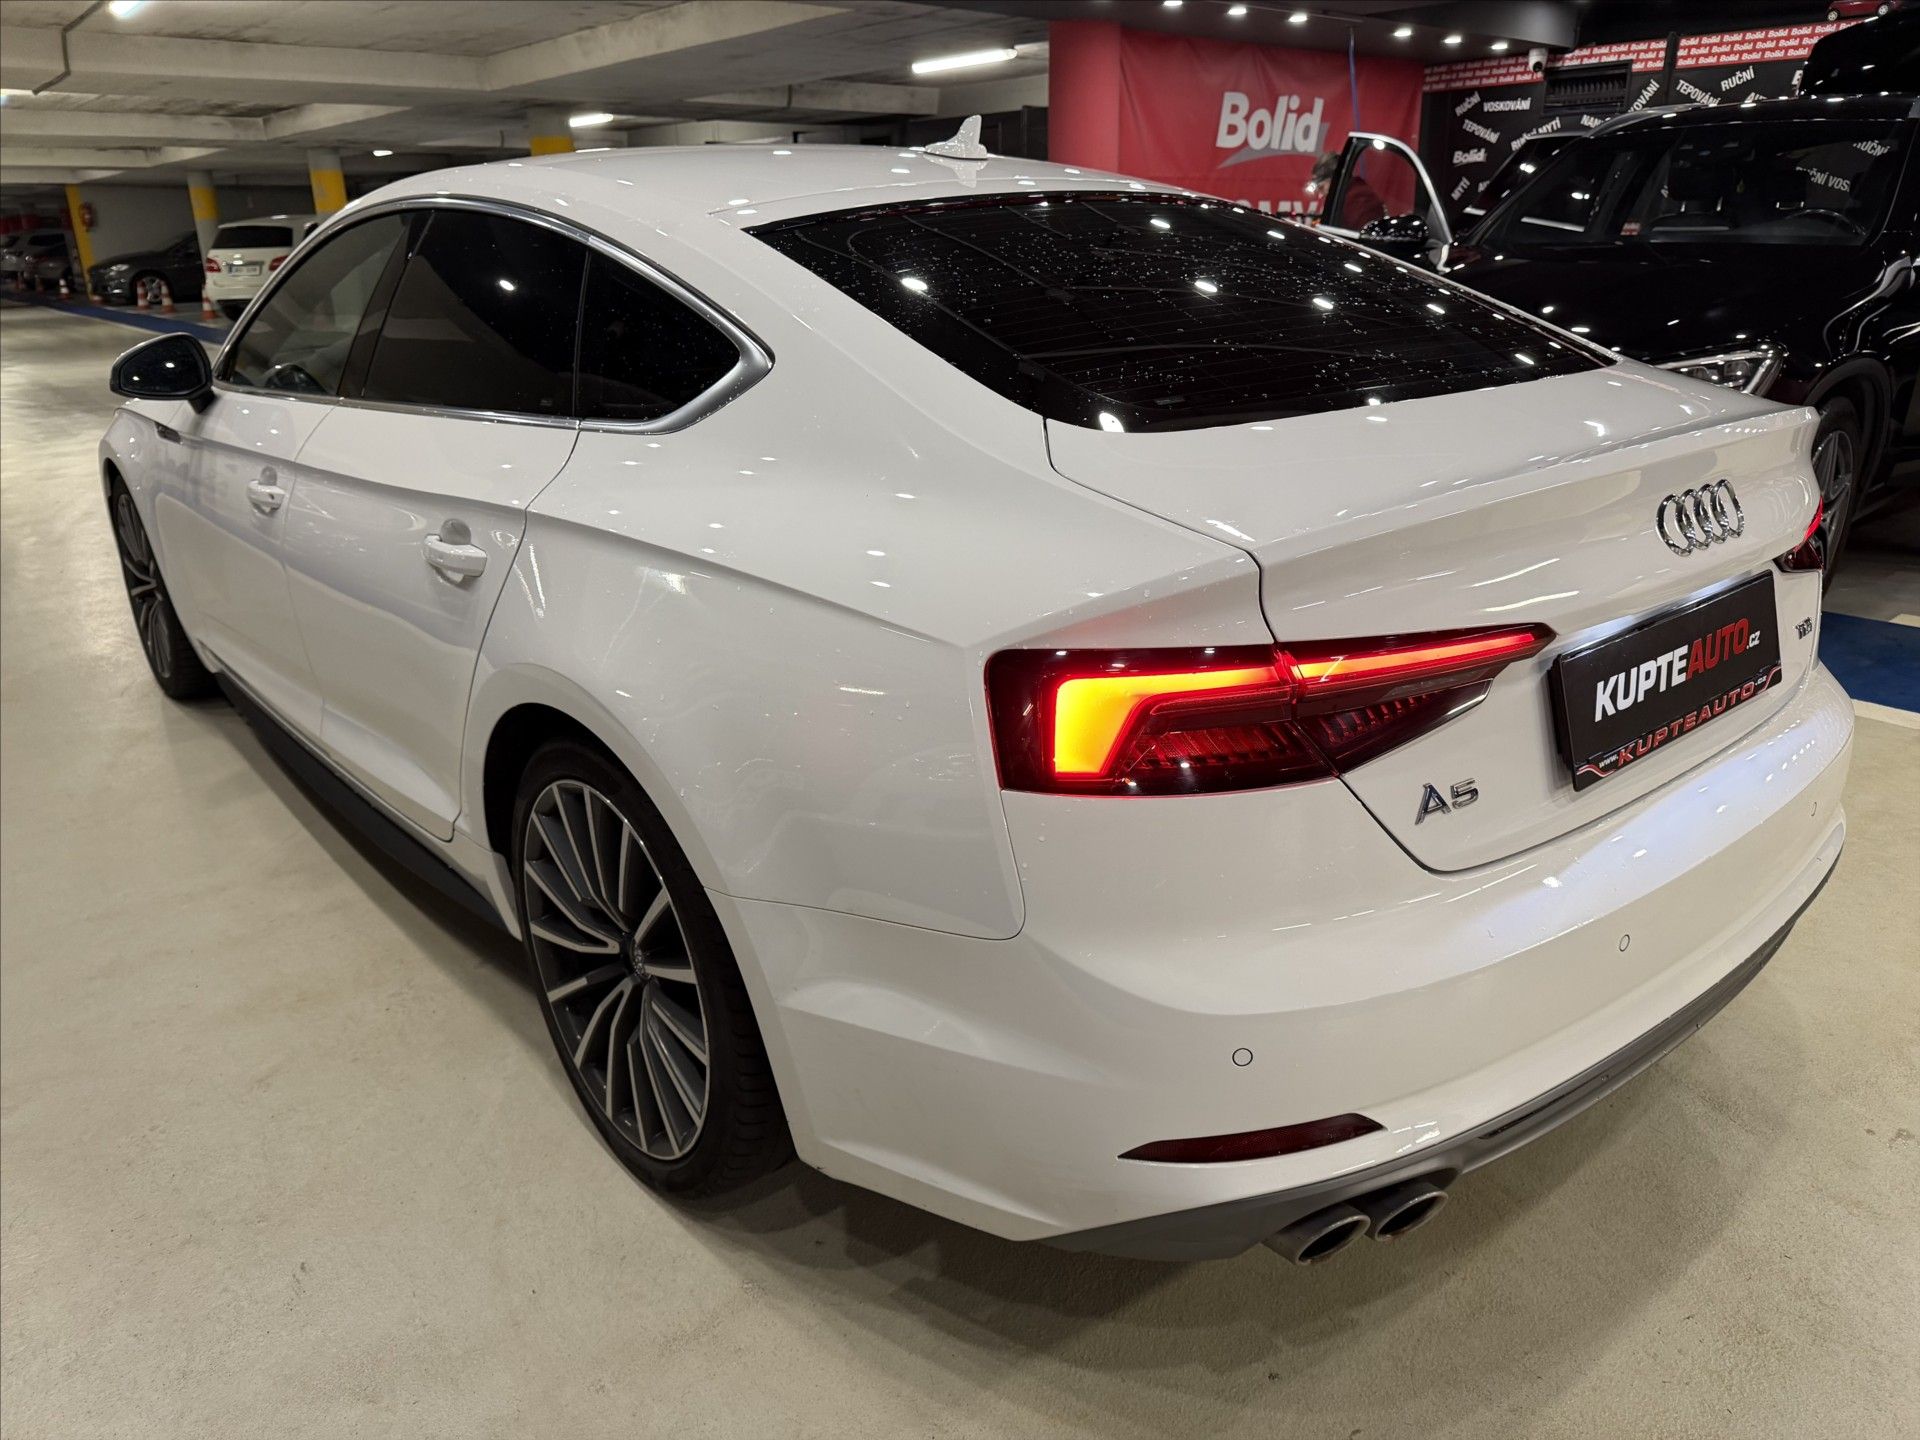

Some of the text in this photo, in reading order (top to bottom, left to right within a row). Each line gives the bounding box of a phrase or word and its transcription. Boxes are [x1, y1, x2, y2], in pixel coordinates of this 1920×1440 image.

[1720, 65, 1755, 92] RUČNÍ
[1483, 96, 1532, 113] VOSKOVÁNÍ
[1675, 79, 1721, 105] TEPOVÁNÍ
[1216, 91, 1325, 153] Bolid
[1452, 147, 1487, 164] Bolid
[1828, 175, 1851, 193] VOS
[1414, 777, 1479, 826] A5
